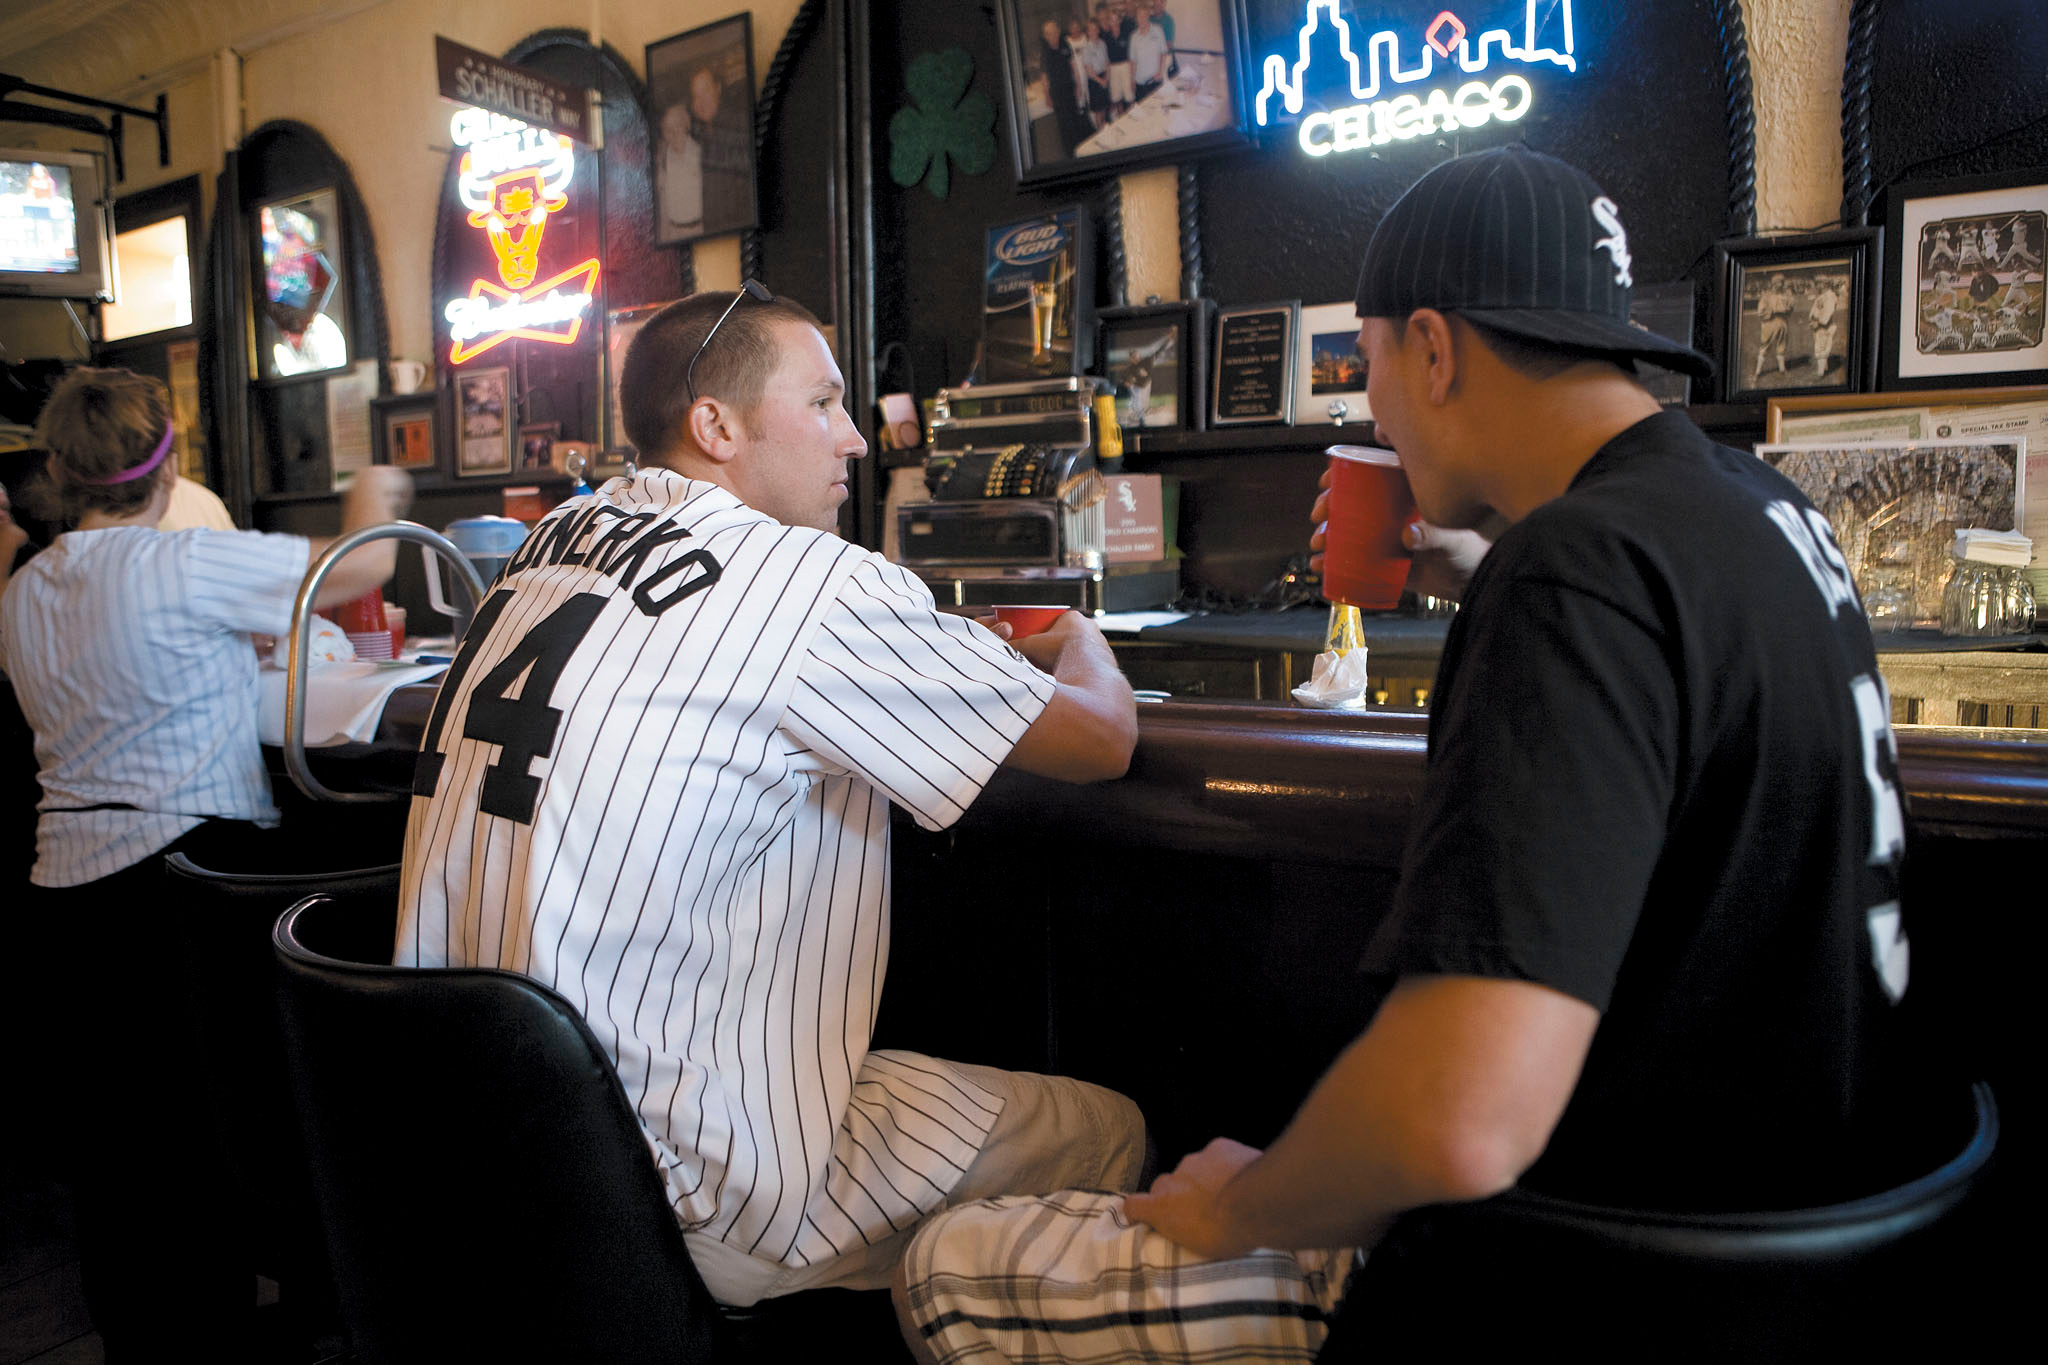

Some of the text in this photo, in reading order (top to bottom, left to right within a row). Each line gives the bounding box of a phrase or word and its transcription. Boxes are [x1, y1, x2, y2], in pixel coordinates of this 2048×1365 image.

[456, 66, 554, 124] SCHALLER
[559, 108, 580, 129] WAY
[1299, 75, 1532, 157] CHICAGO
[1004, 237, 1064, 258] LIGHT
[1015, 223, 1059, 245] BUD
[1961, 425, 1988, 433] SPECIAL
[2005, 420, 2029, 428] STAMP
[496, 504, 724, 618] ONERKO
[412, 587, 611, 826] 14
